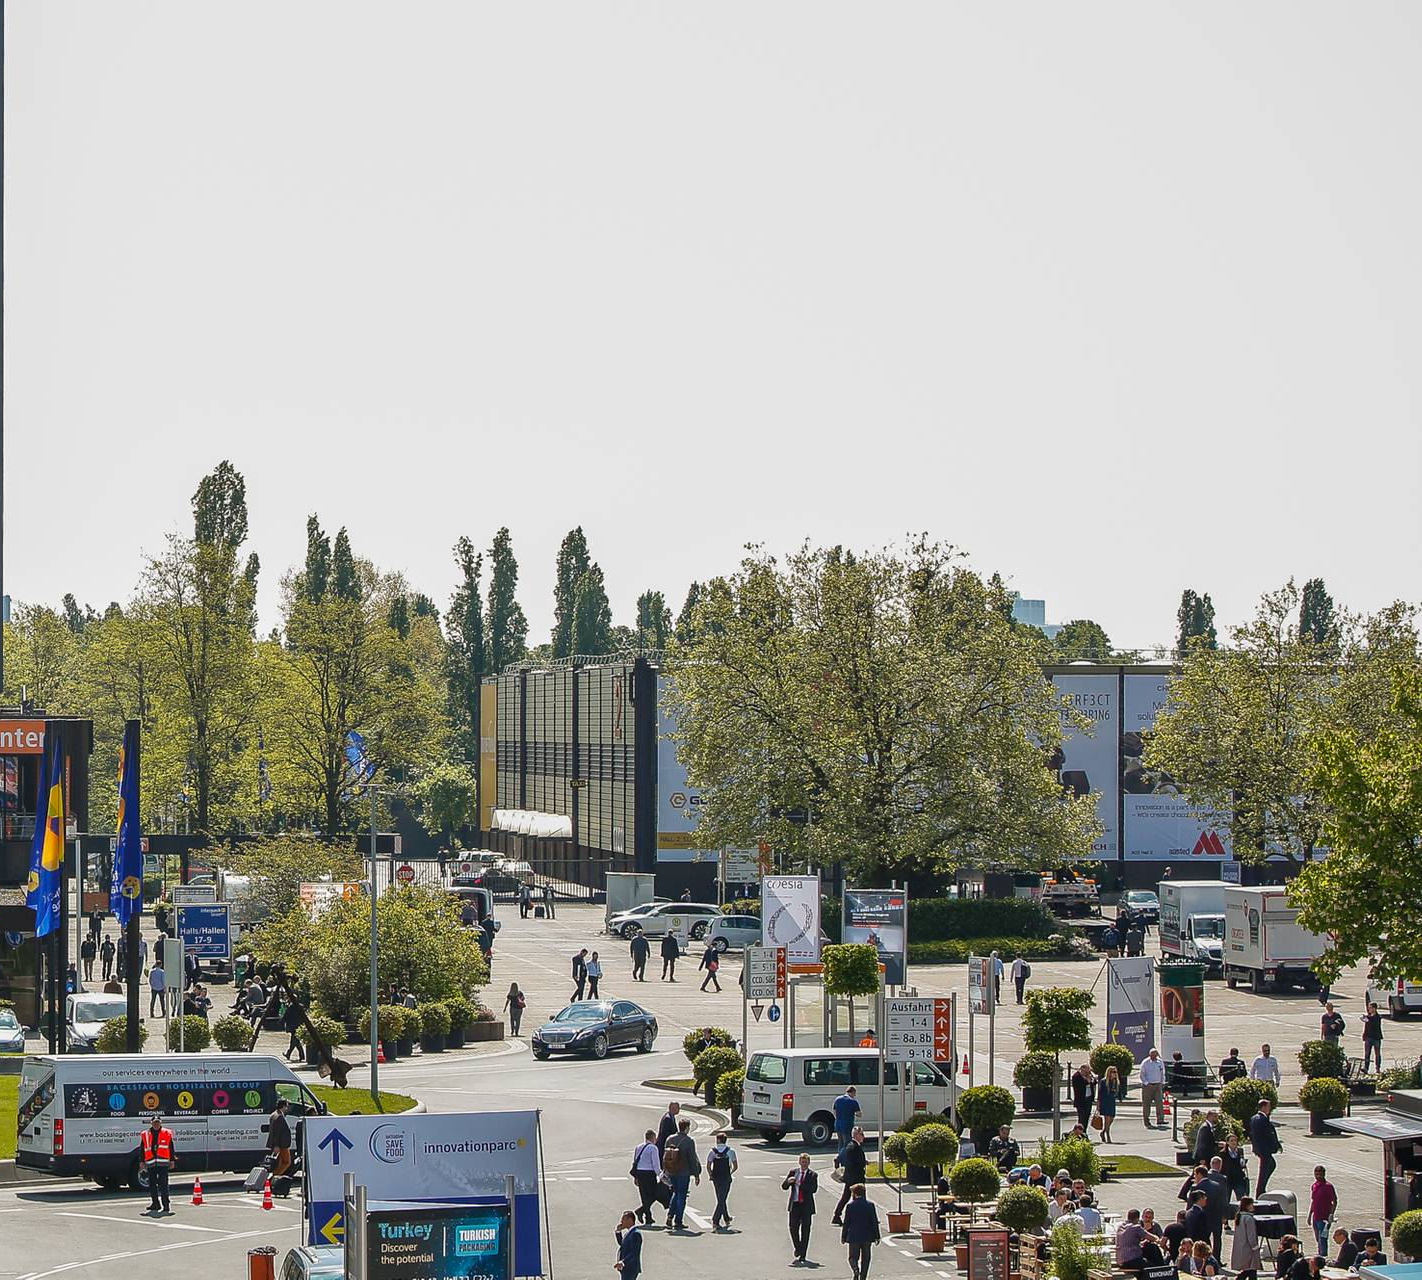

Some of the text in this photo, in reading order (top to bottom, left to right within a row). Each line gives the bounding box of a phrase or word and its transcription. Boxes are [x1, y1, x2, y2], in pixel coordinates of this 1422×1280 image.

[398, 869, 414, 879] STOP
[180, 927, 226, 935] Halls/Hallen
[194, 936, 212, 944] 17-9
[890, 1002, 932, 1012] Ausfahrt
[902, 1033, 917, 1044] 8a,
[919, 1033, 932, 1043] 8b
[115, 1069, 144, 1077] services
[146, 1068, 188, 1077] everywhere
[189, 1067, 197, 1075] in
[198, 1067, 209, 1075] the
[211, 1066, 230, 1075] world
[385, 1139, 404, 1148] SAVE
[424, 1139, 516, 1154] innovationparc
[385, 1148, 405, 1157] FOOD
[378, 1222, 433, 1240] Turkey
[459, 1229, 496, 1241] TURKISH
[381, 1243, 418, 1253] Discover
[459, 1242, 496, 1252] PACKAGING
[381, 1253, 434, 1266] the potential
